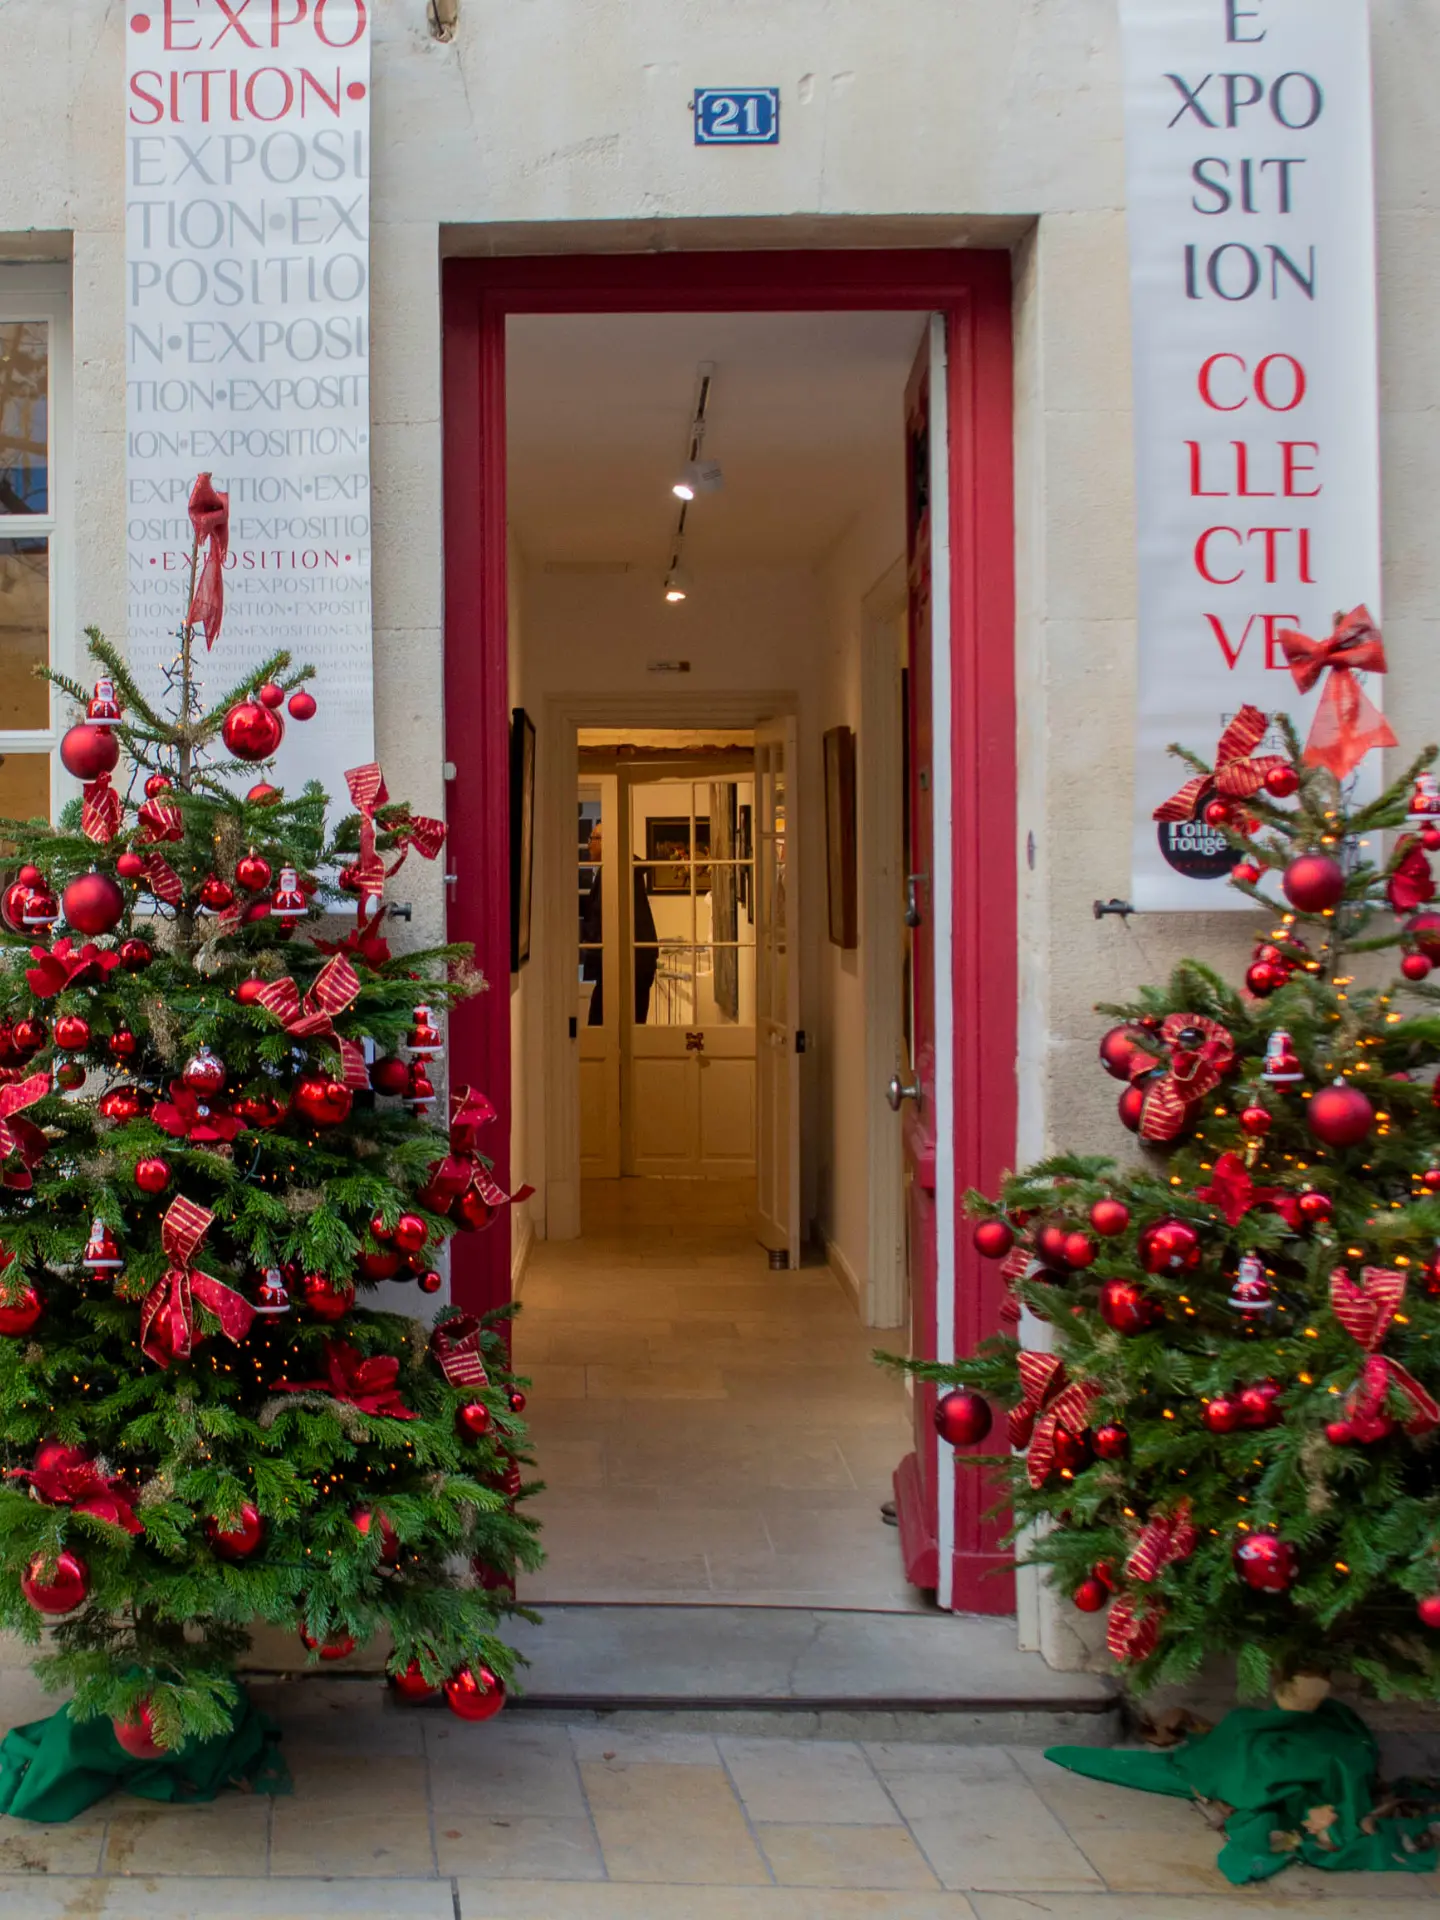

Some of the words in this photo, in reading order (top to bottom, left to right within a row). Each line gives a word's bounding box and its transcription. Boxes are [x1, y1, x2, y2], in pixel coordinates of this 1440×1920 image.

[1223, 0, 1268, 43] E
[711, 97, 760, 135] 21
[1162, 71, 1325, 130] XPO
[129, 129, 369, 187] EXPOSI
[1191, 157, 1307, 215] SIT
[127, 252, 367, 307] POSITIO
[1184, 242, 1315, 301] ION
[1197, 353, 1307, 412] CO
[1183, 440, 1324, 497] LLE
[1194, 526, 1317, 585] CTI
[1203, 613, 1300, 671] VE
[1168, 837, 1228, 856] rouge
